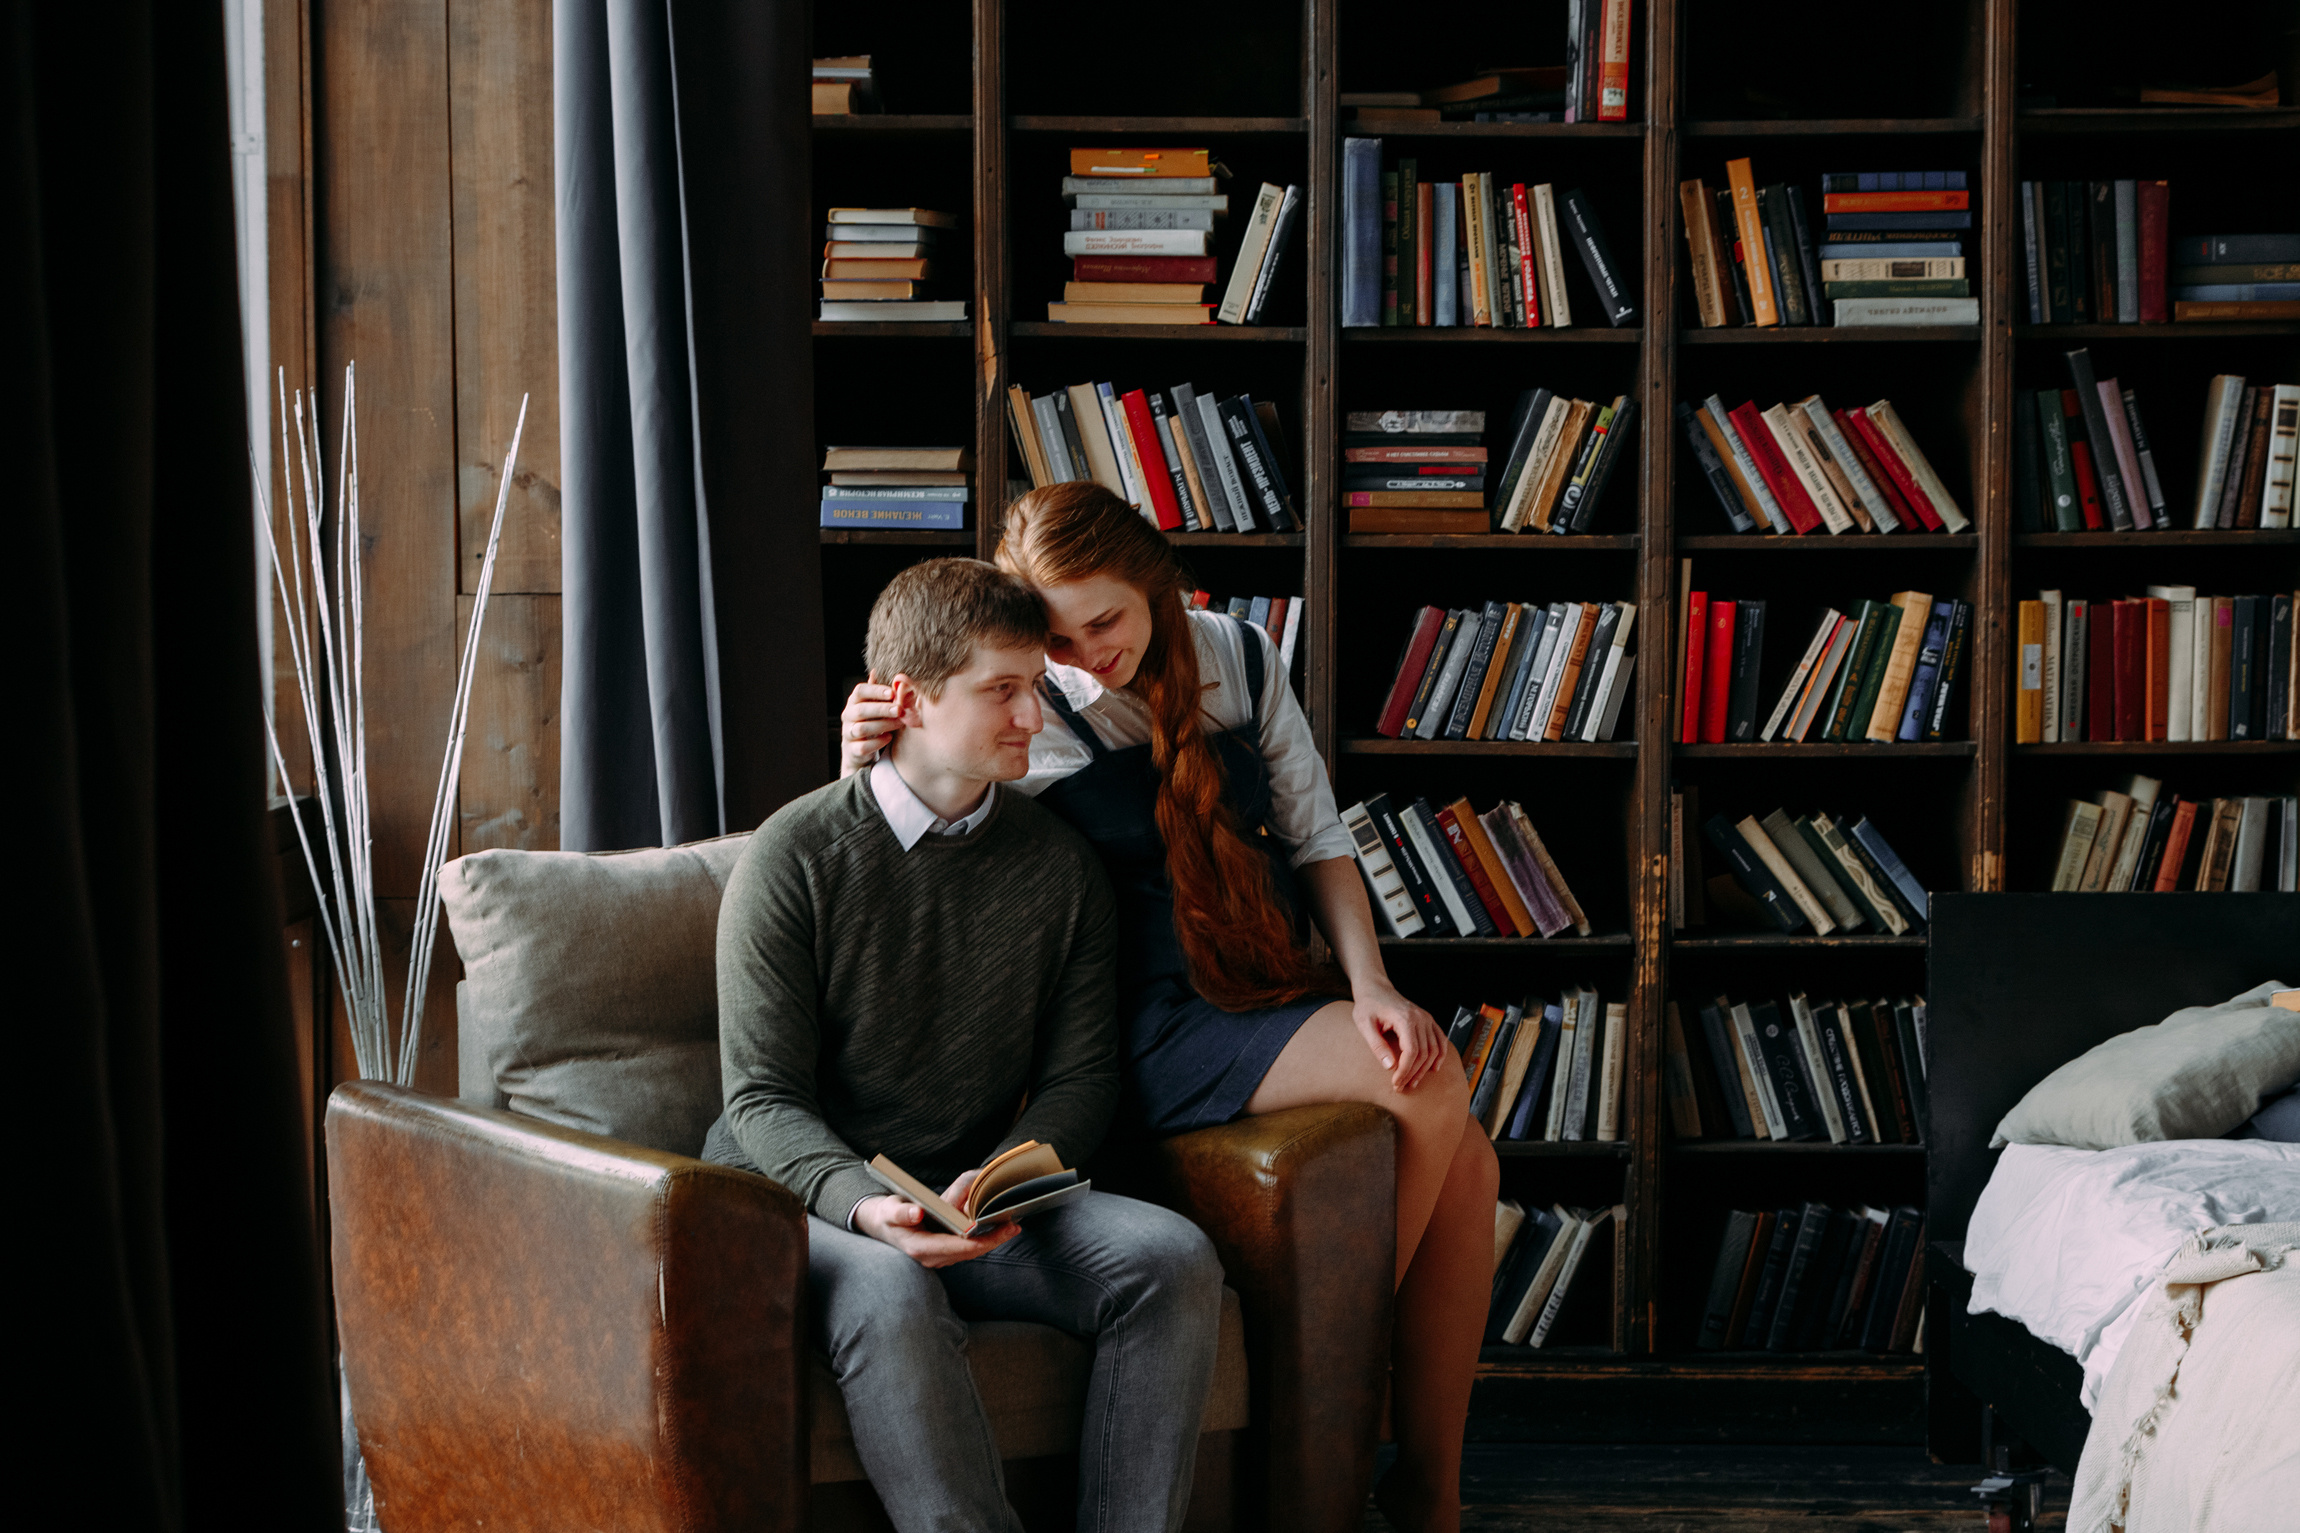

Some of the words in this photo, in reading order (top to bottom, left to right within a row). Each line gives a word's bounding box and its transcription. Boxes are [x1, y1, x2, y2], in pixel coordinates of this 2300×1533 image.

[1738, 186, 1748, 199] 2
[1867, 307, 1900, 315] ЧИНГИЗ
[1902, 305, 1948, 314] АЙТМАТОВ
[1221, 454, 1237, 485] ВОЗРАСТ
[838, 489, 876, 497] ИСТОРИЯ
[876, 489, 925, 498] ВСЕМИРНАЯ
[1230, 485, 1249, 522] НЕЖНЫЙ
[832, 508, 869, 519] ВЕКОВ
[870, 508, 922, 521] ЖЕЛАНИЕ
[1453, 664, 1482, 722] ВСЕМИРНАЯ
[1471, 618, 1499, 664] ИСТОРИЯ
[2042, 655, 2055, 730] МАТЕМАТИКА
